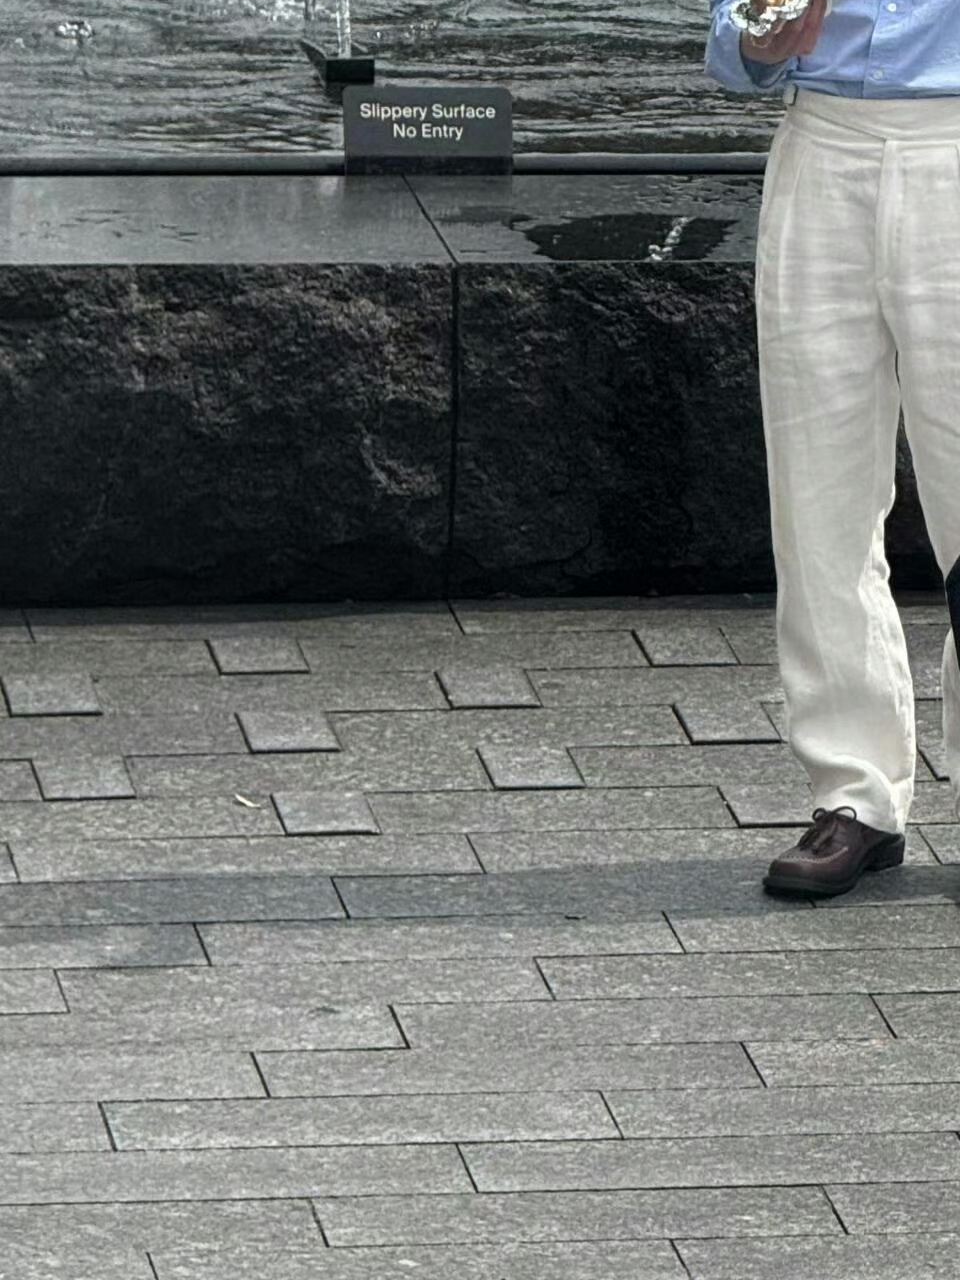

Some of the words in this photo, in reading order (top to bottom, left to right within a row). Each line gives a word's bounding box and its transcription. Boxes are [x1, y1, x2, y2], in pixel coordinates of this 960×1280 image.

[360, 103, 427, 120] Slippery
[431, 103, 496, 118] Surface
[393, 123, 417, 138] No
[421, 123, 463, 141] Entry
